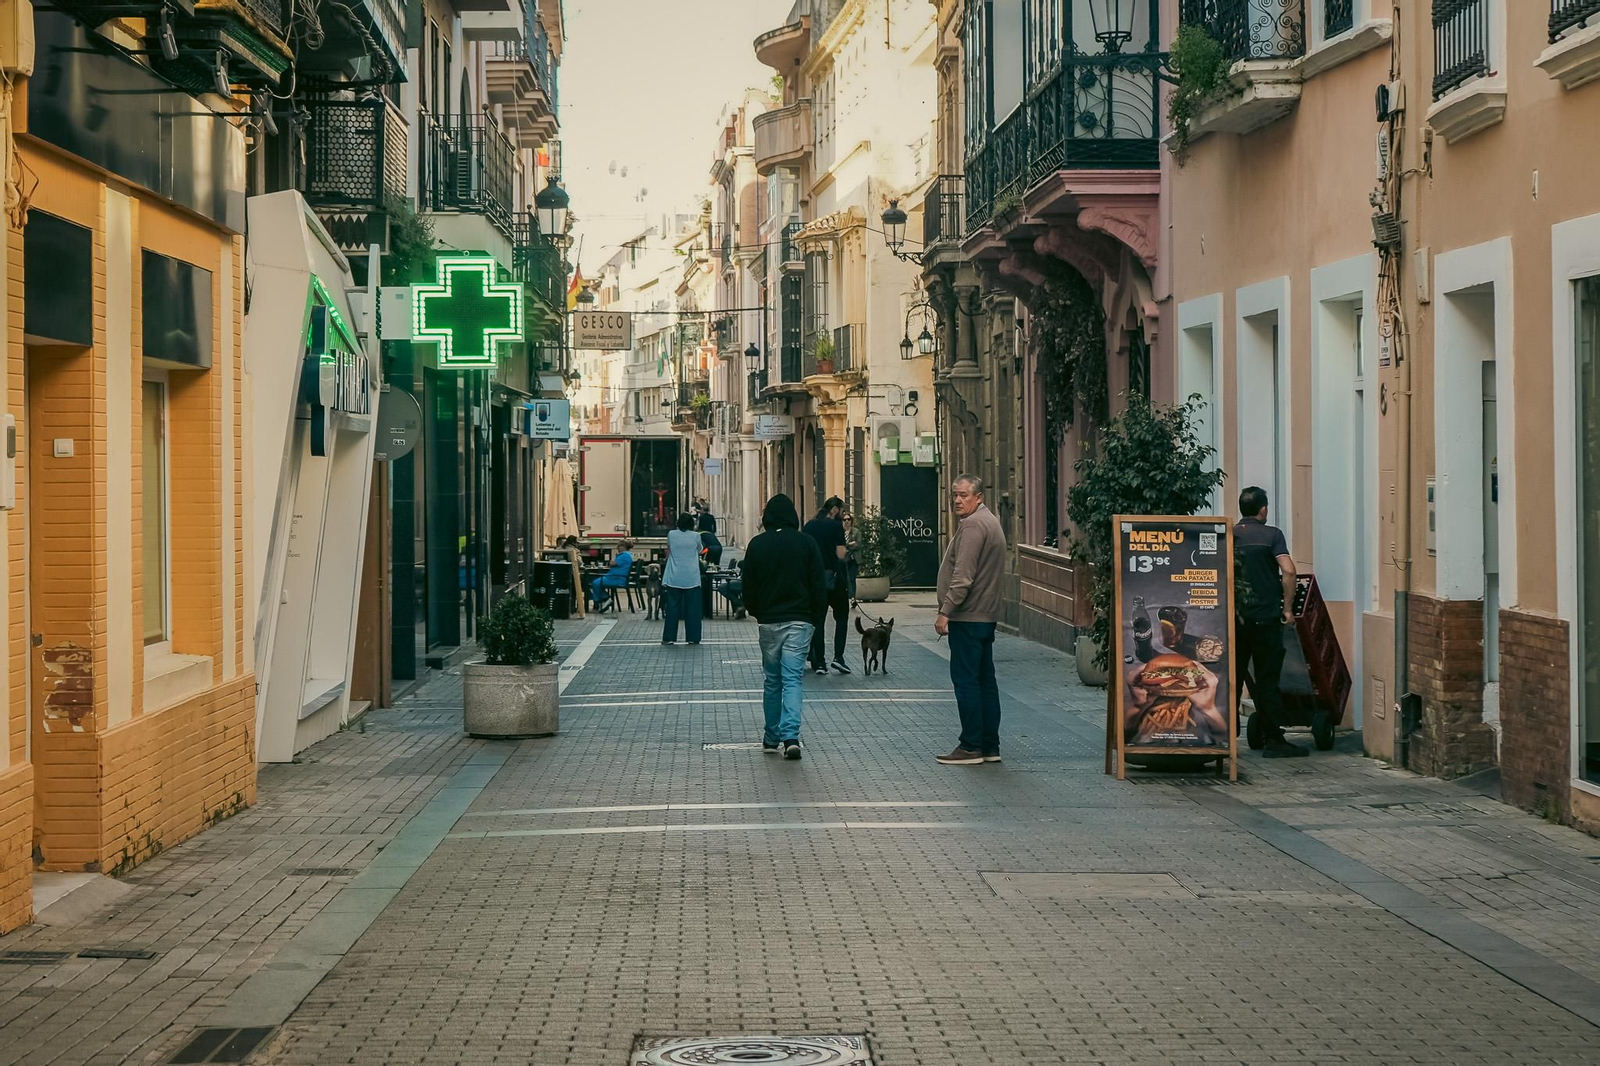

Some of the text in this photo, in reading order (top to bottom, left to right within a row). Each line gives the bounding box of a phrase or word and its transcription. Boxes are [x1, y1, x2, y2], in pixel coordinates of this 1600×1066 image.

[581, 315, 624, 329] GESCO
[887, 517, 924, 529] SANTO
[902, 527, 932, 537] VICIO
[1130, 528, 1185, 544] MENÚ
[1129, 541, 1171, 552] DEL DÍA
